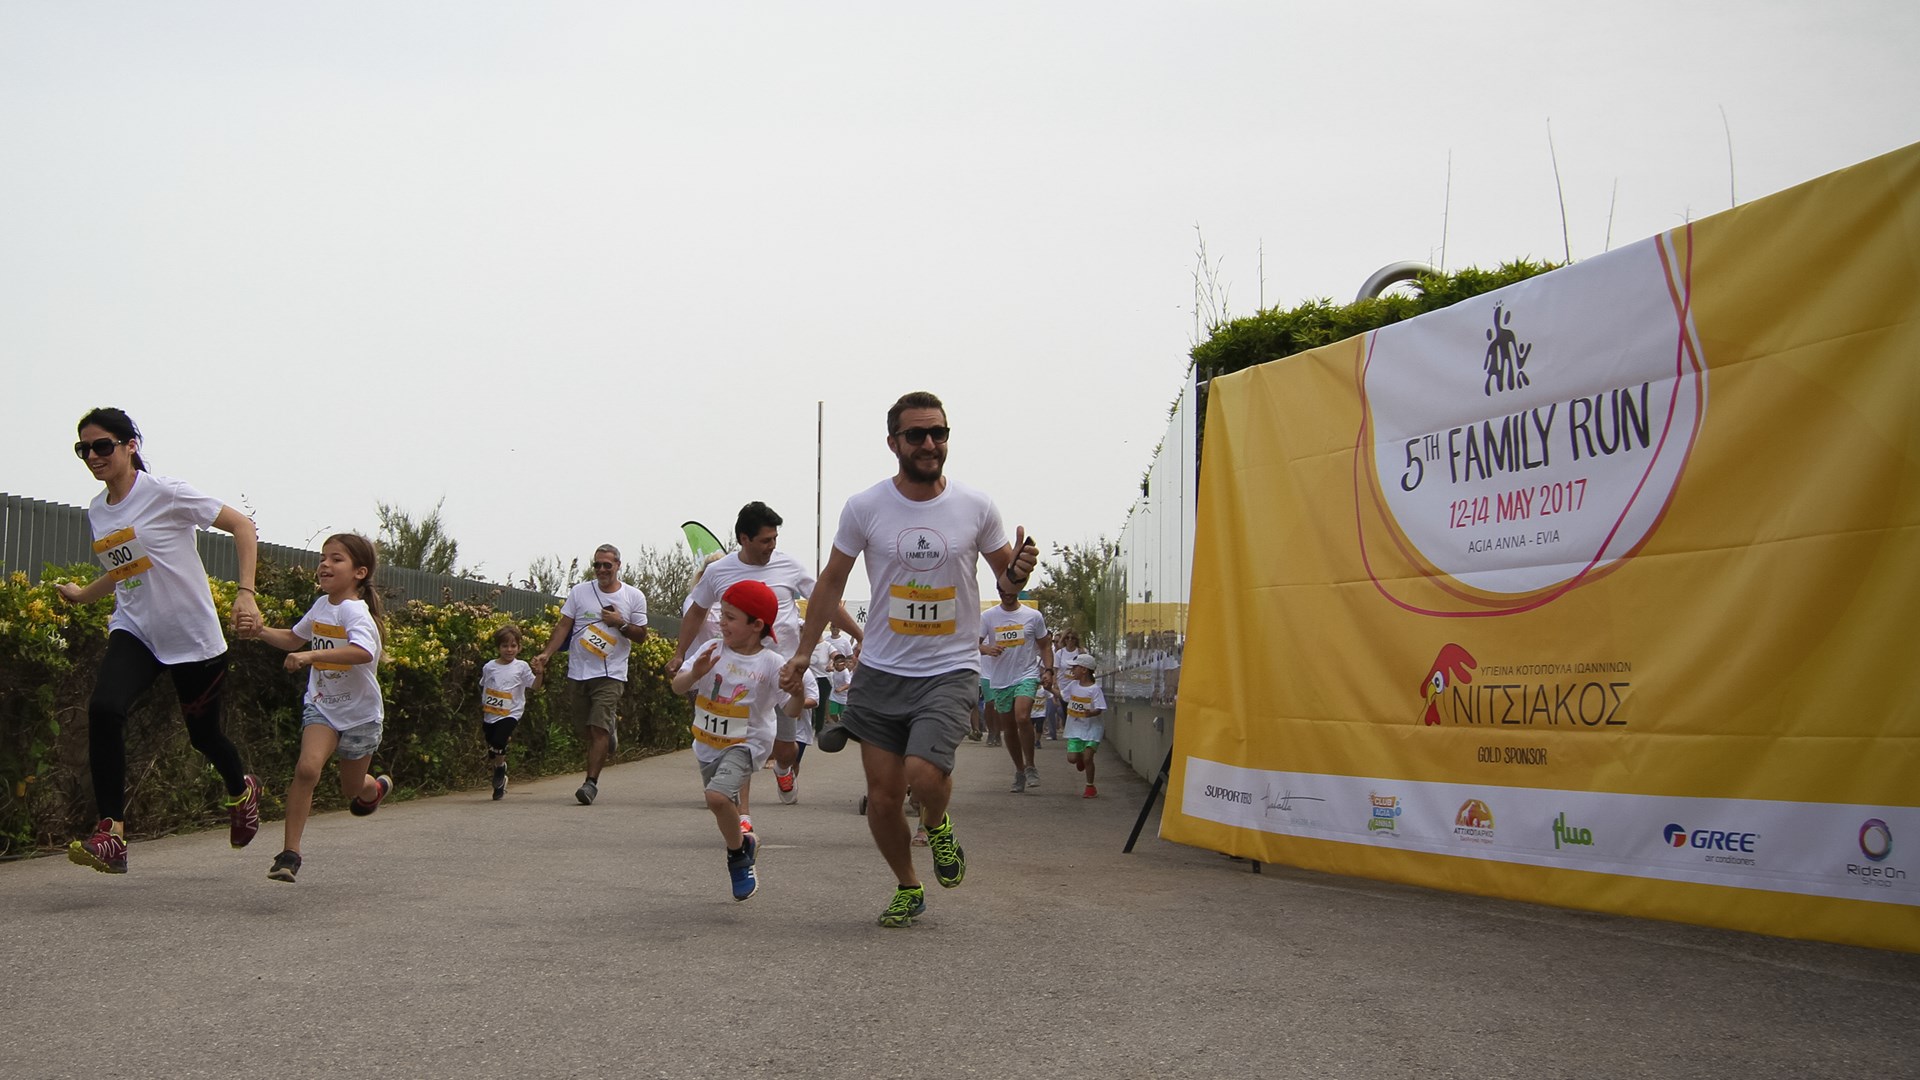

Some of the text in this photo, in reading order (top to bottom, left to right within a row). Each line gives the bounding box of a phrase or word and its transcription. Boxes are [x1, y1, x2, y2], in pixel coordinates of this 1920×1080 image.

[1400, 381, 1651, 492] 5TH FAMILY RUN
[1449, 478, 1588, 529] 12-14 MAY 2017
[1468, 538, 1493, 554] AGIA
[1495, 534, 1526, 550] ANNA
[1536, 529, 1561, 546] EVIA
[108, 546, 133, 567] 300
[905, 551, 940, 559] FAMILY RUN
[906, 603, 938, 620] 111
[312, 636, 334, 650] 300
[589, 634, 607, 650] 224
[1002, 631, 1018, 640] 109
[1516, 662, 1573, 676] ΚΟΤΟΠΟΥΛΑ
[1574, 661, 1632, 674] ΙΩΑΝΝΙΝΩΝ
[486, 696, 504, 708] 224
[1071, 702, 1084, 711] 109
[1453, 682, 1630, 726] ΝΙΤΣΙΑΚΟΣ
[704, 714, 728, 735] 111
[1478, 746, 1548, 765] GOLD SPONSOR
[1374, 797, 1392, 806] CLUB
[1690, 829, 1756, 853] GREE
[1704, 854, 1756, 866] air conditioners
[1846, 863, 1906, 879] Ride On
